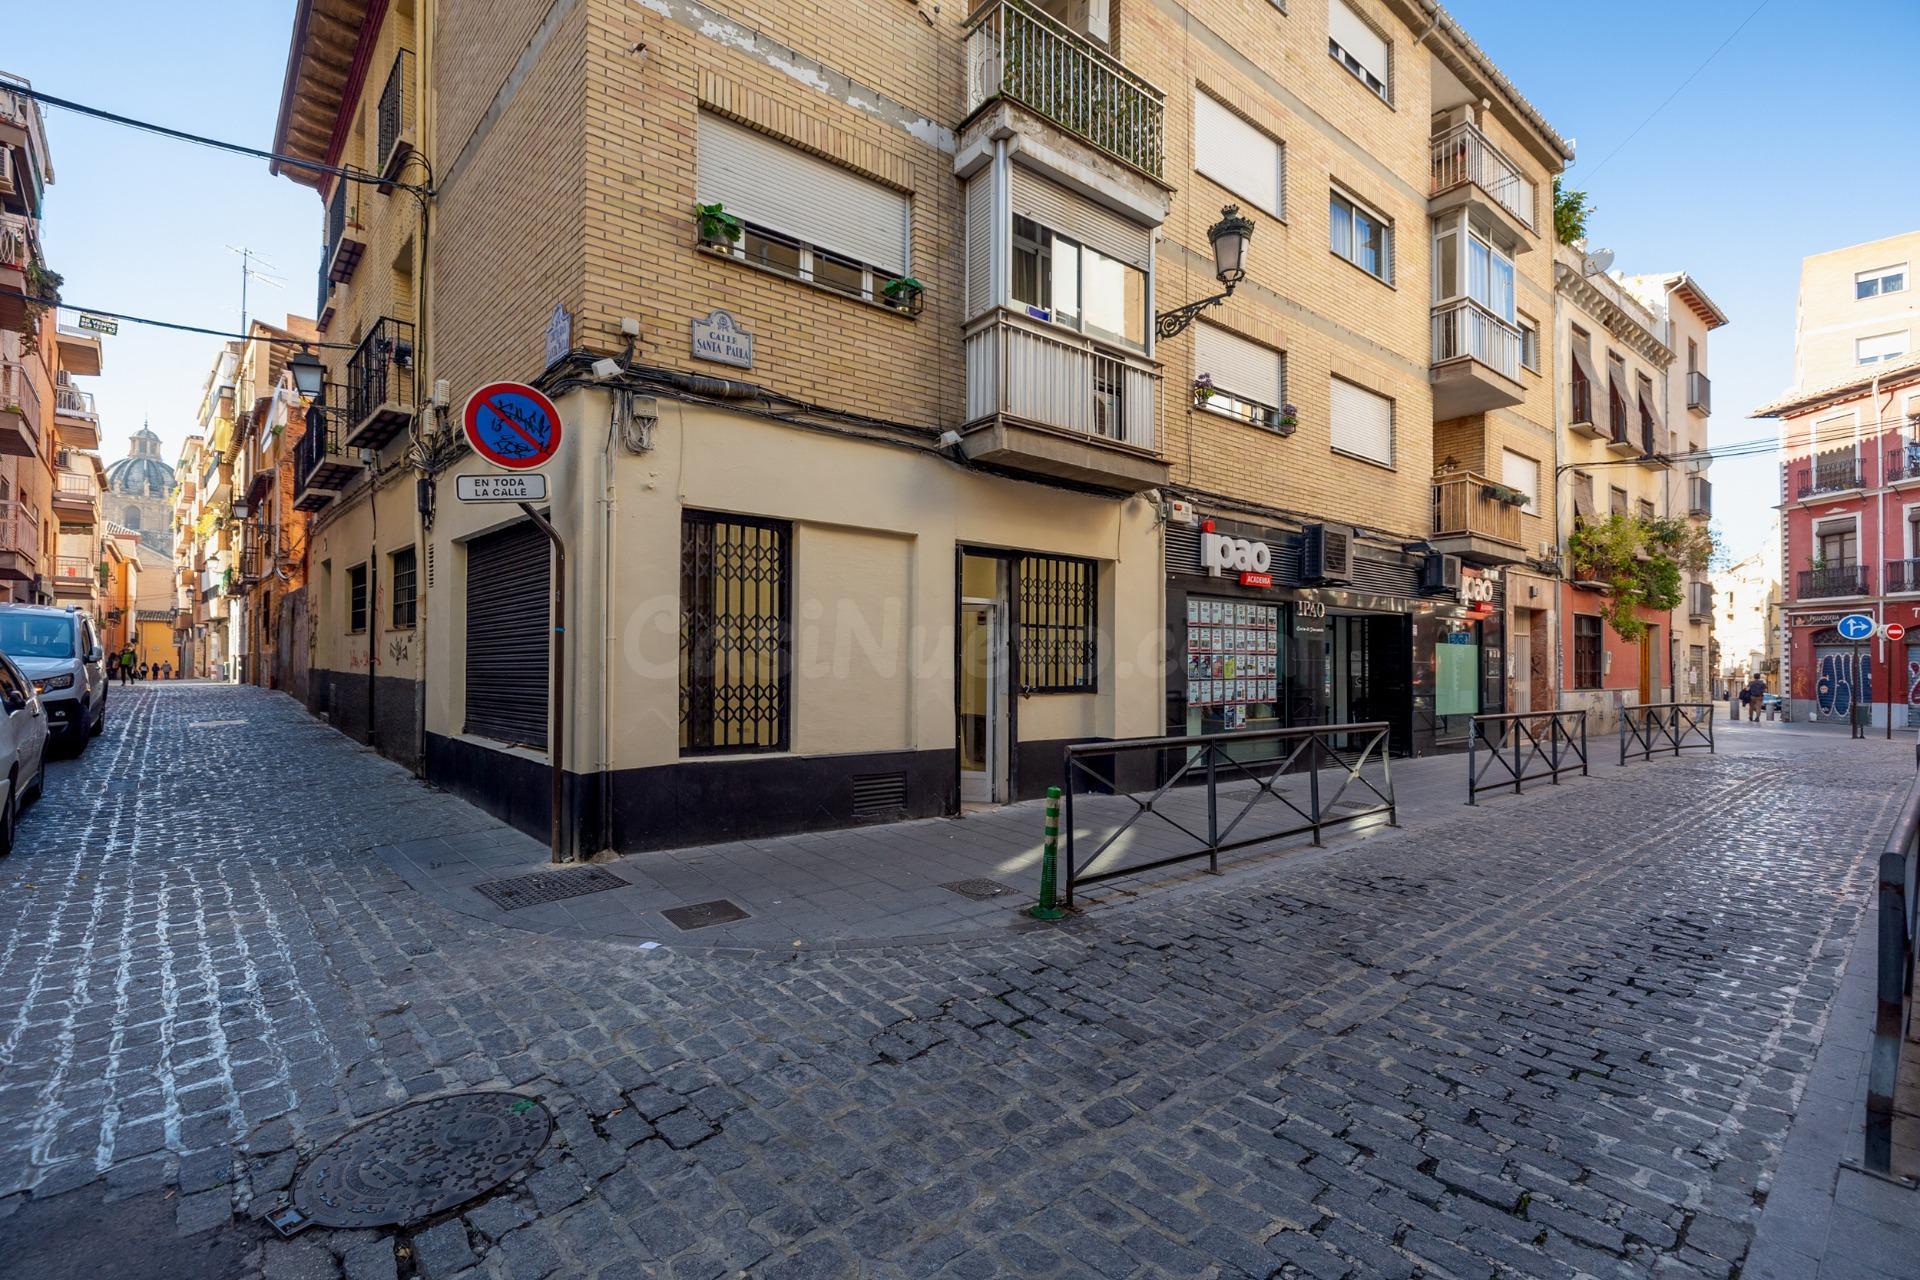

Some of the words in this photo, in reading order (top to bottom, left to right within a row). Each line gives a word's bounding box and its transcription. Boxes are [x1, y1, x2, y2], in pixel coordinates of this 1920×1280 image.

[697, 338, 721, 353] SANTA
[726, 344, 749, 359] PAULA
[474, 479, 489, 487] EN
[494, 478, 525, 487] TODA
[475, 488, 489, 497] LA
[492, 487, 527, 497] CALLE
[1201, 519, 1271, 577] ipao
[1247, 575, 1271, 585] ACADEMIA
[1296, 600, 1325, 618] IPAO
